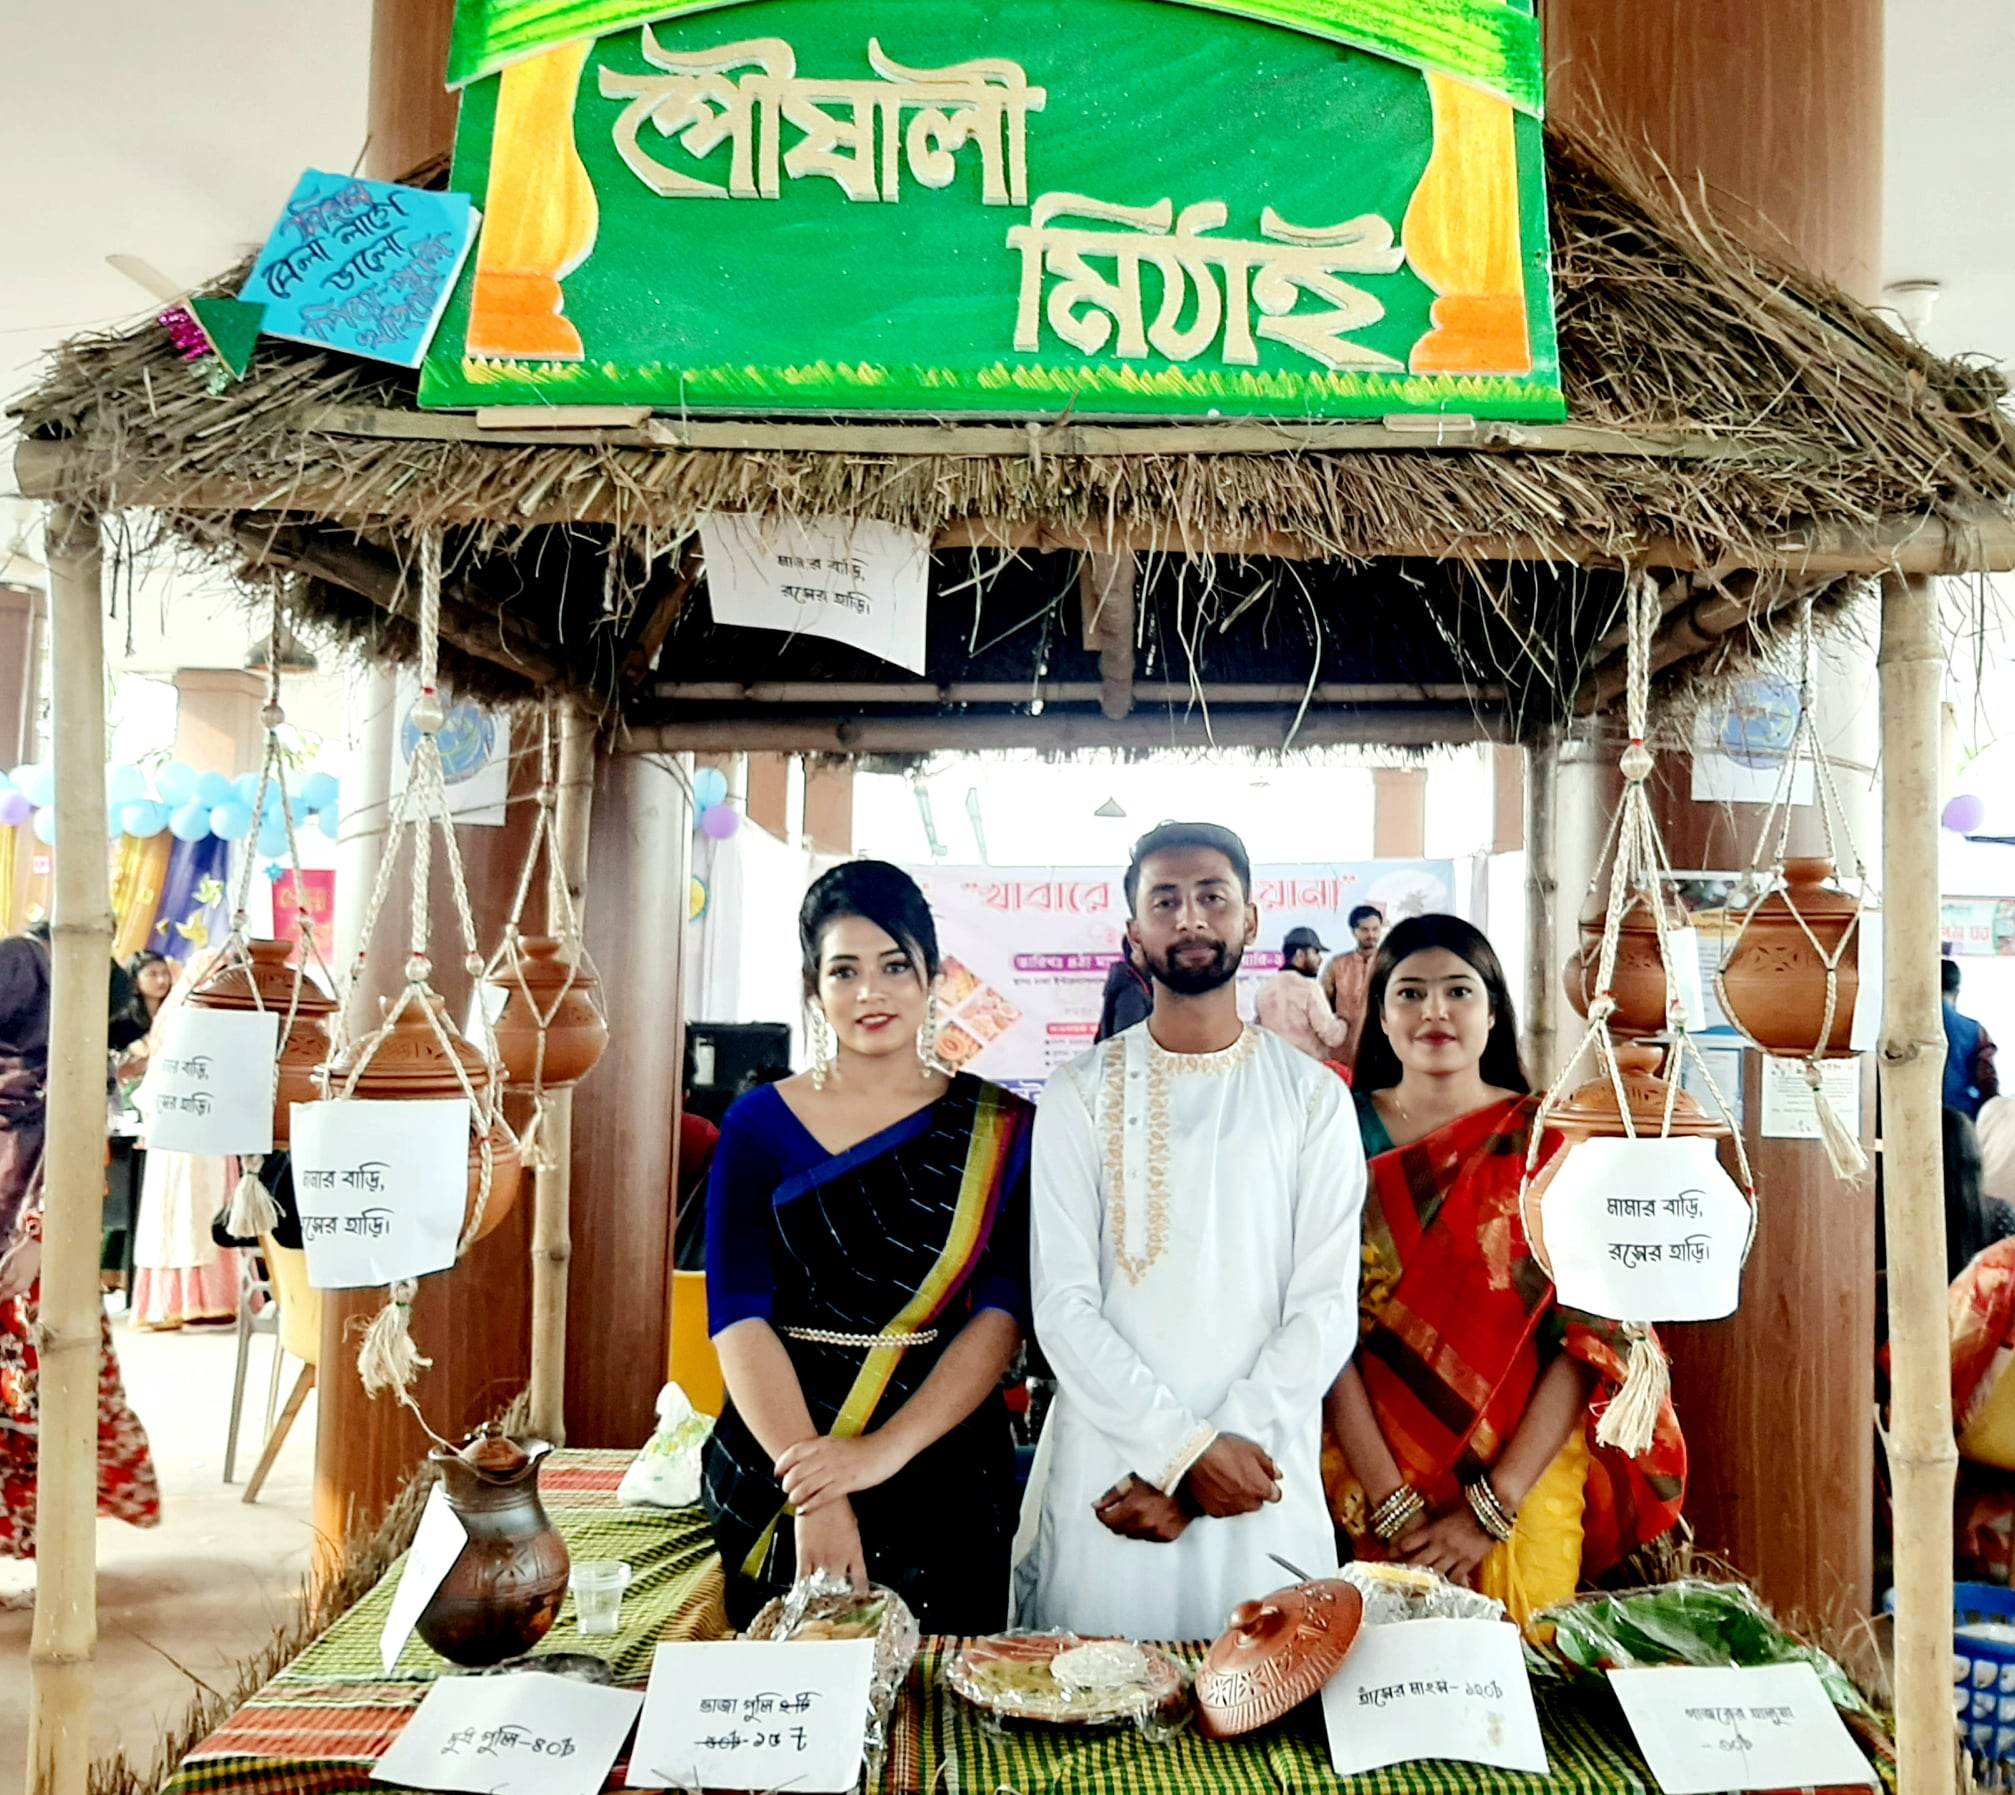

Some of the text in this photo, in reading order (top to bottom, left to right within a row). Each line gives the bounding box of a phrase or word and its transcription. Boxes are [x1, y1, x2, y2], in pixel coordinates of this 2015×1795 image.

[598, 23, 1047, 206] পৌষালী
[261, 190, 411, 299] বেলা লাগে
[320, 225, 409, 291] ভালো
[1006, 191, 1406, 373] মিঠাই
[1606, 1197, 1657, 1218] মামার
[1608, 1242, 1663, 1269] রসের
